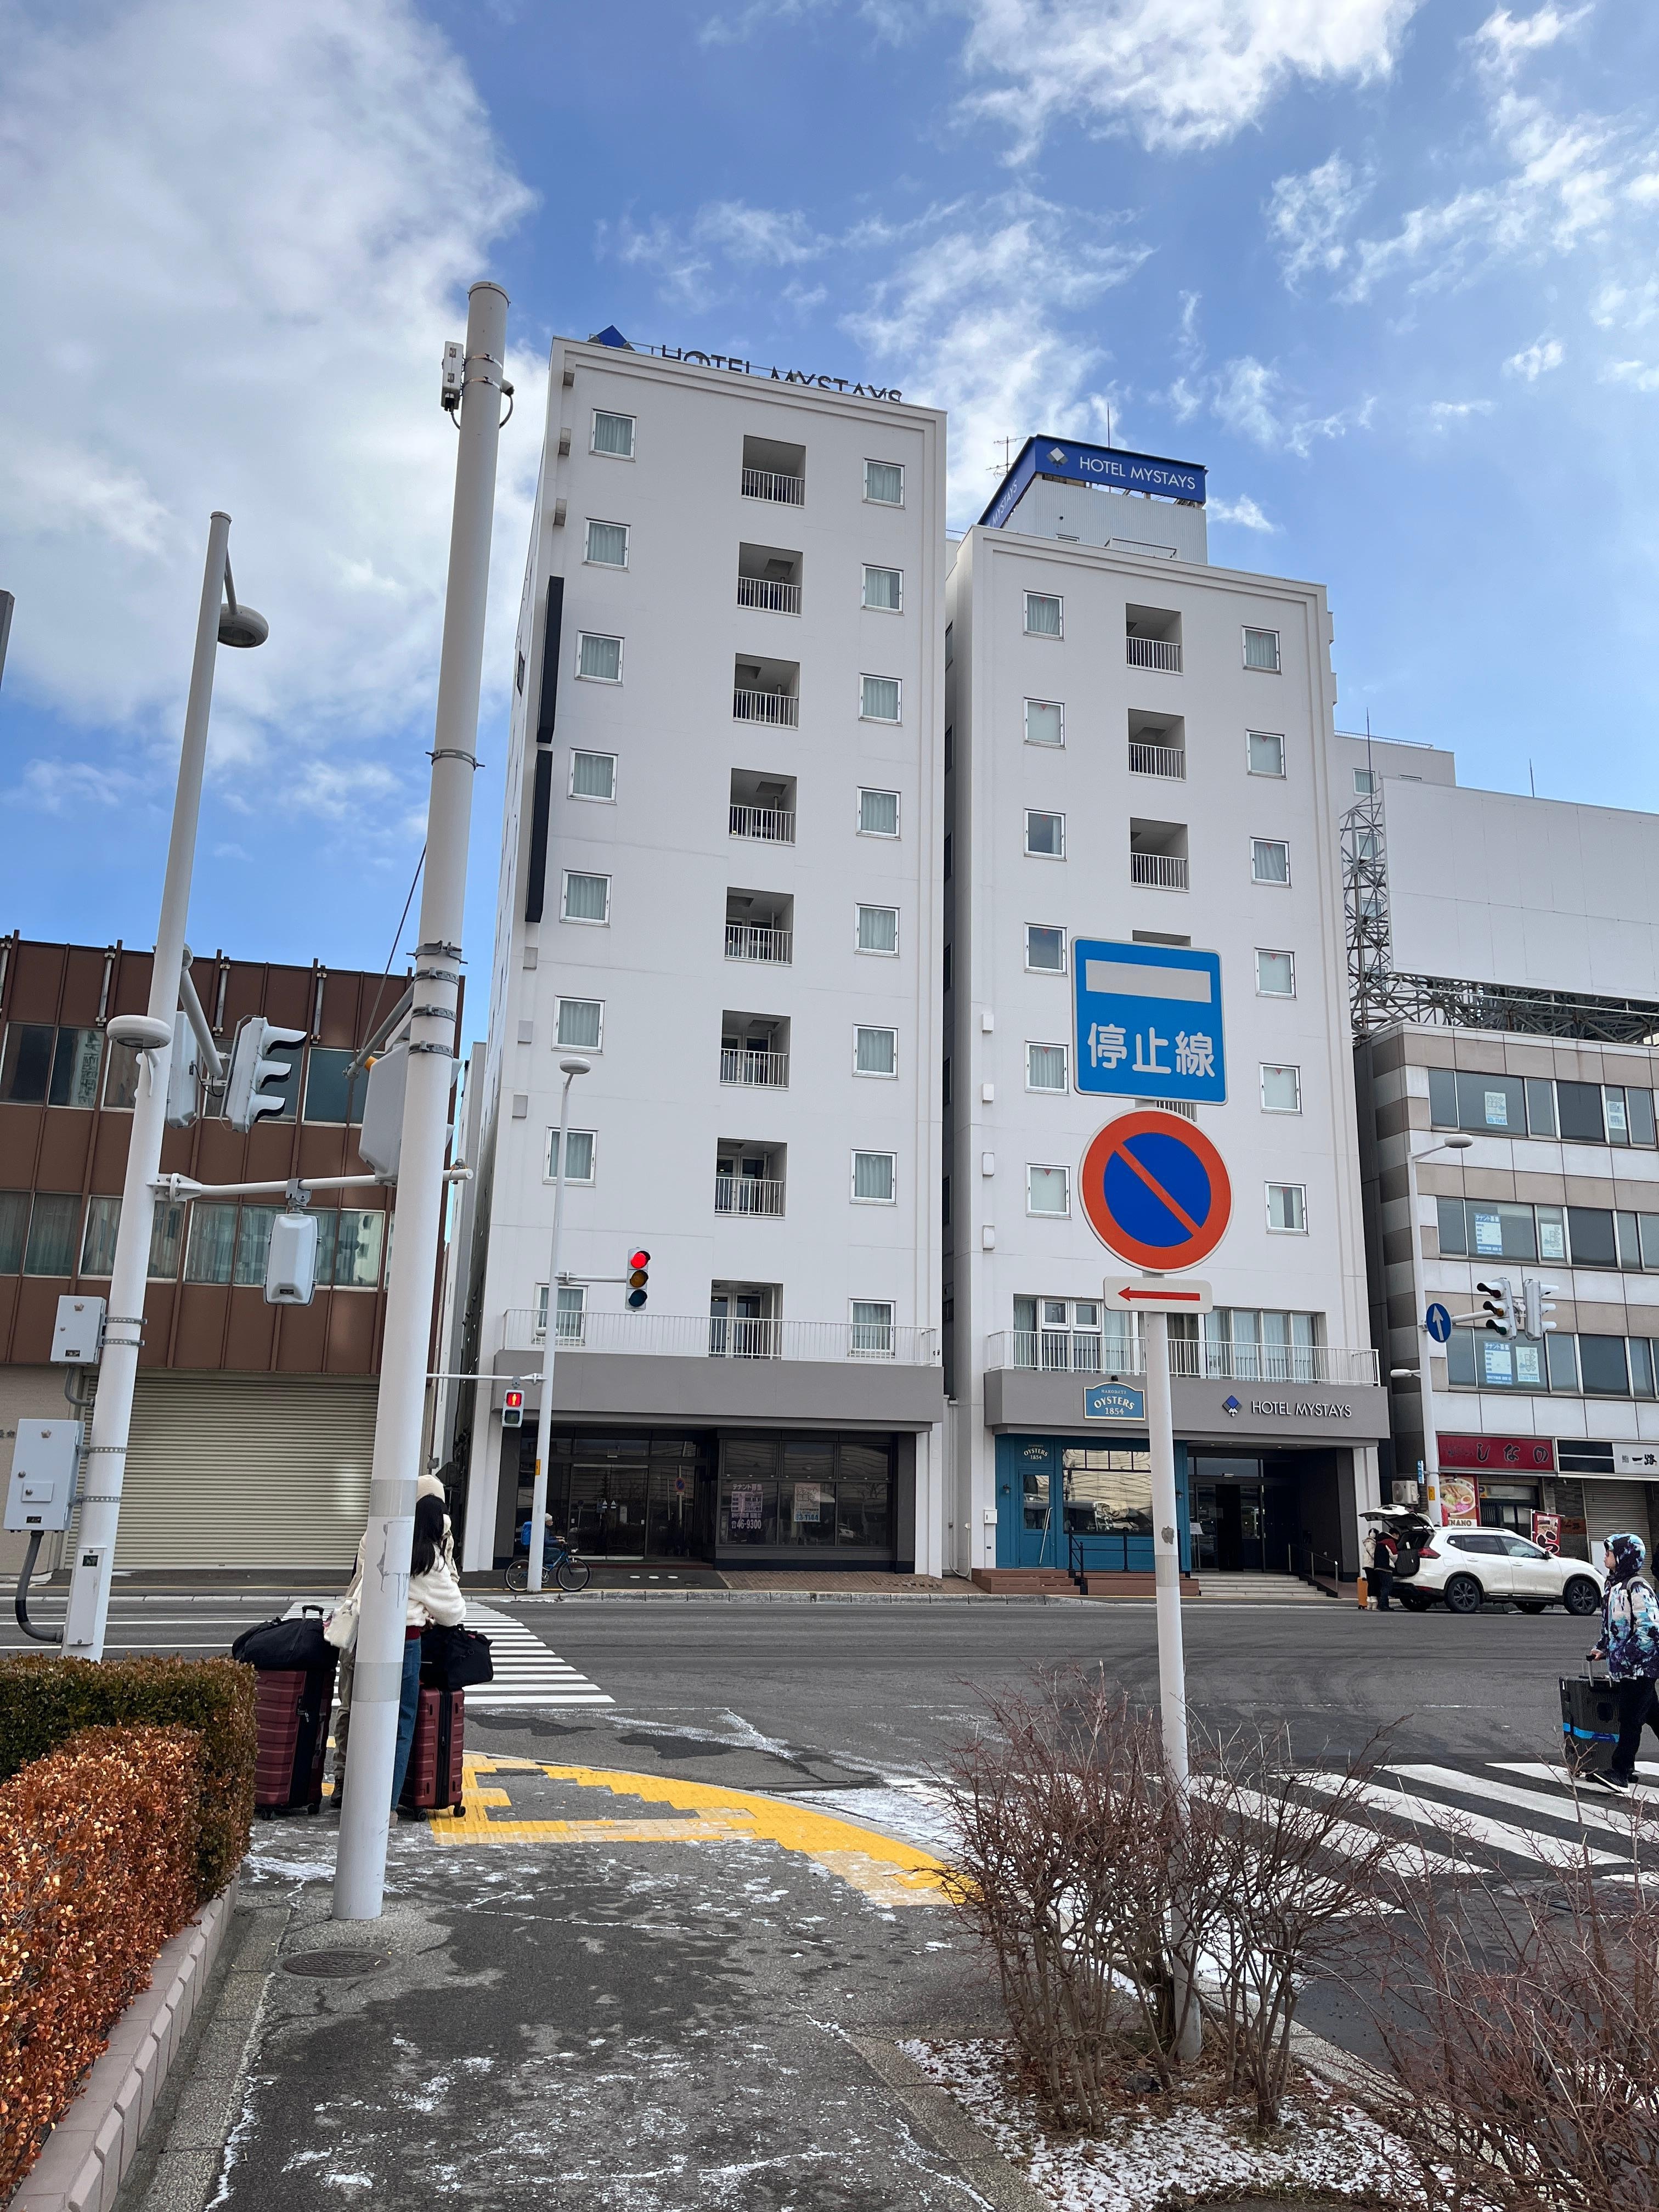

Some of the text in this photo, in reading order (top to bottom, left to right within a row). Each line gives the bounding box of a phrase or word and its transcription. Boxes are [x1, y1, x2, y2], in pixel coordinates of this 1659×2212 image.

[1080, 456, 1196, 490] HOTEL MYSTAYS
[992, 479, 1017, 527] MYSTAYS
[1087, 1022, 1216, 1077] 停止線
[1094, 1396, 1135, 1410] OYSTERS
[1251, 1401, 1352, 1418] HOTEL MYSTAYS
[1024, 1448, 1048, 1457] OYSTERS
[1476, 1442, 1549, 1464] しなの
